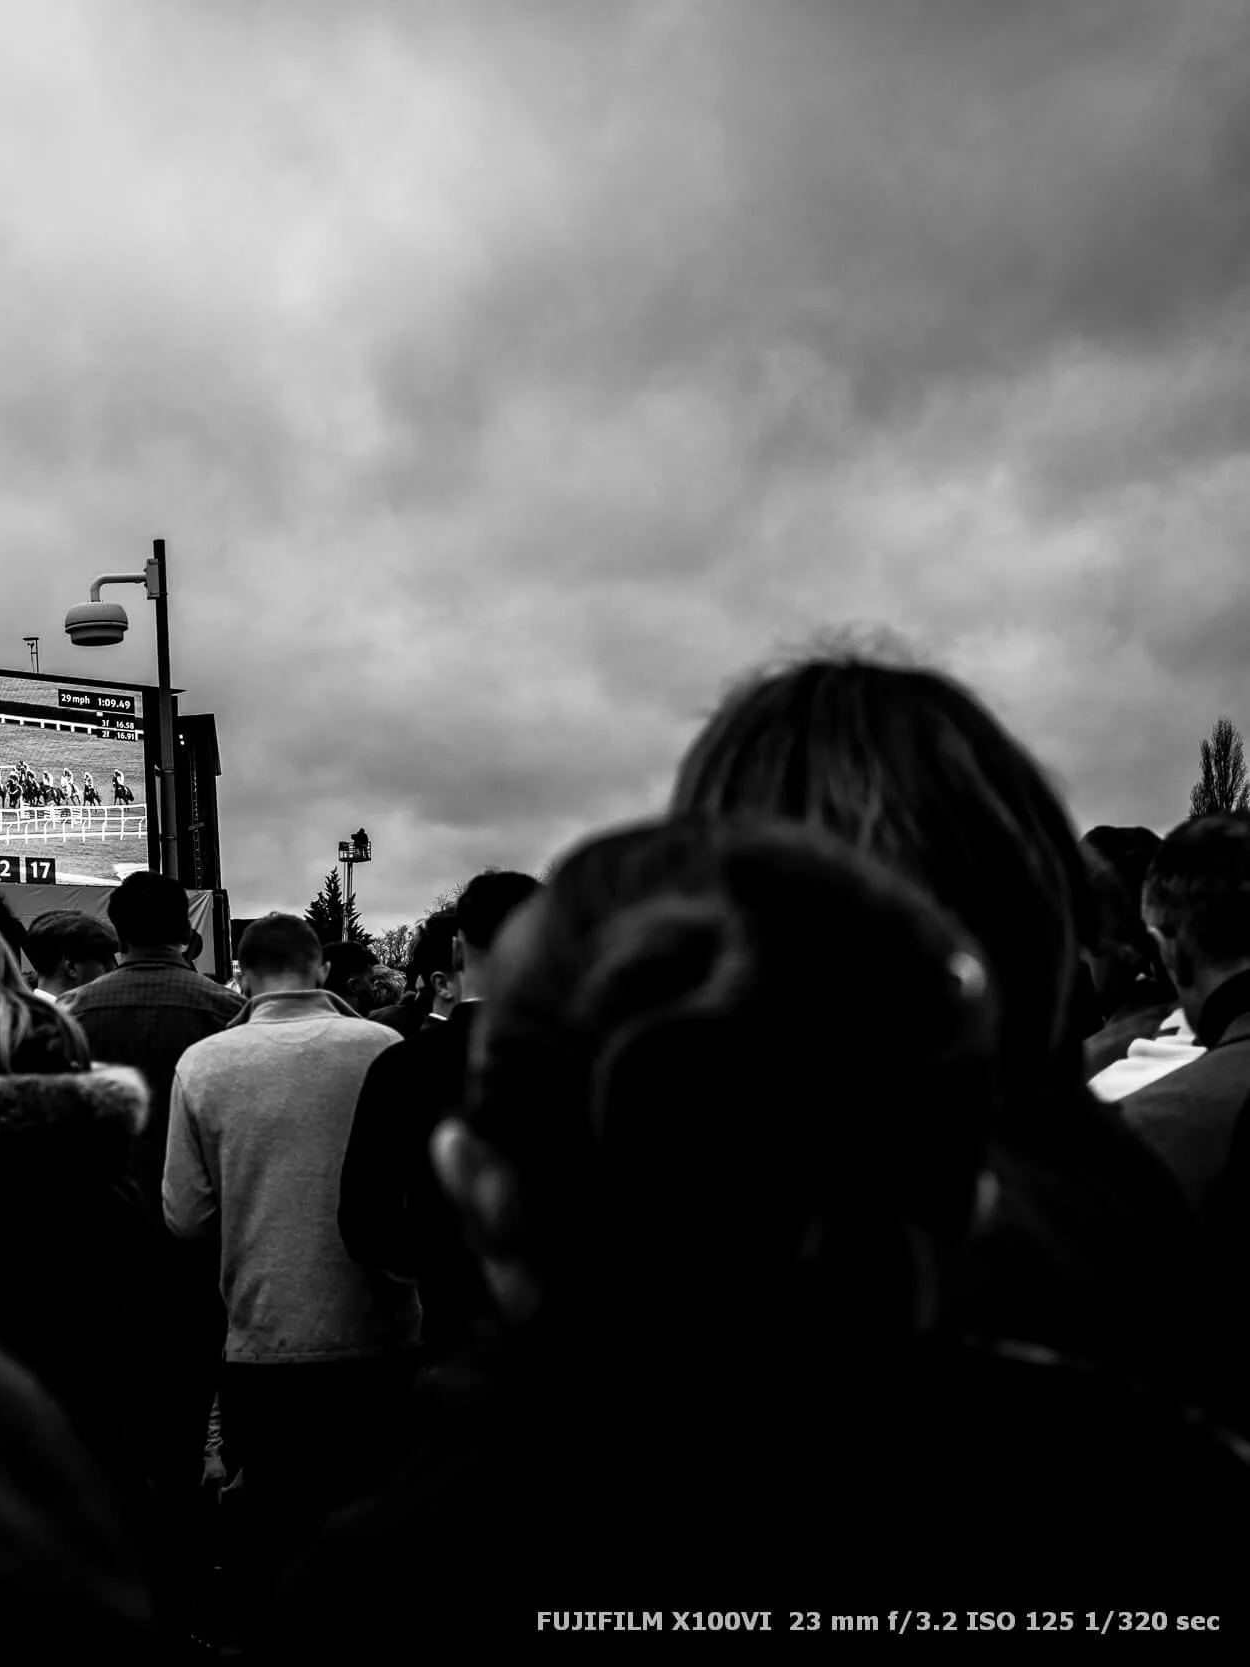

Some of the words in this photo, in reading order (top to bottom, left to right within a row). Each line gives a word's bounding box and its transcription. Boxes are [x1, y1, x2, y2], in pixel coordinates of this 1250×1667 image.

[98, 698, 131, 709] 1:09.49
[0, 860, 12, 877] 2
[30, 861, 51, 879] 17
